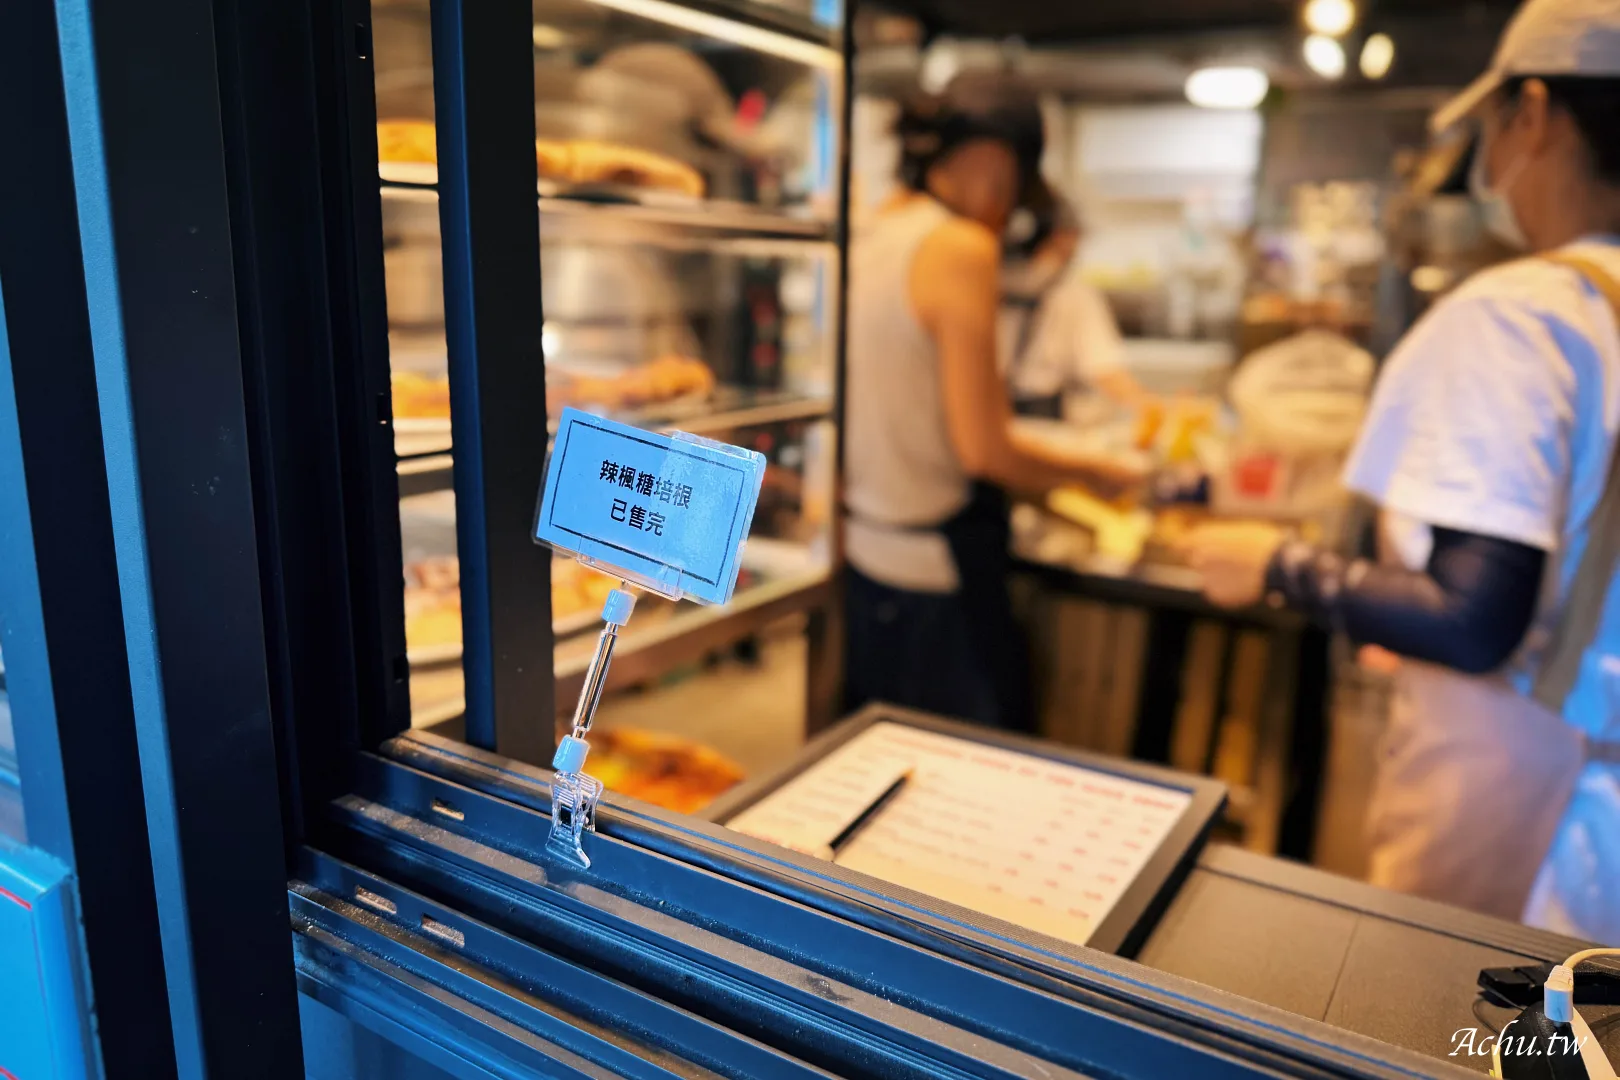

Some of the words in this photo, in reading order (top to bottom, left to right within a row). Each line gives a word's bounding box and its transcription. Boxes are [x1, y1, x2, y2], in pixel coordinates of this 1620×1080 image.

[599, 459, 693, 510] 辣楓糖培根
[610, 498, 666, 537] 已售完
